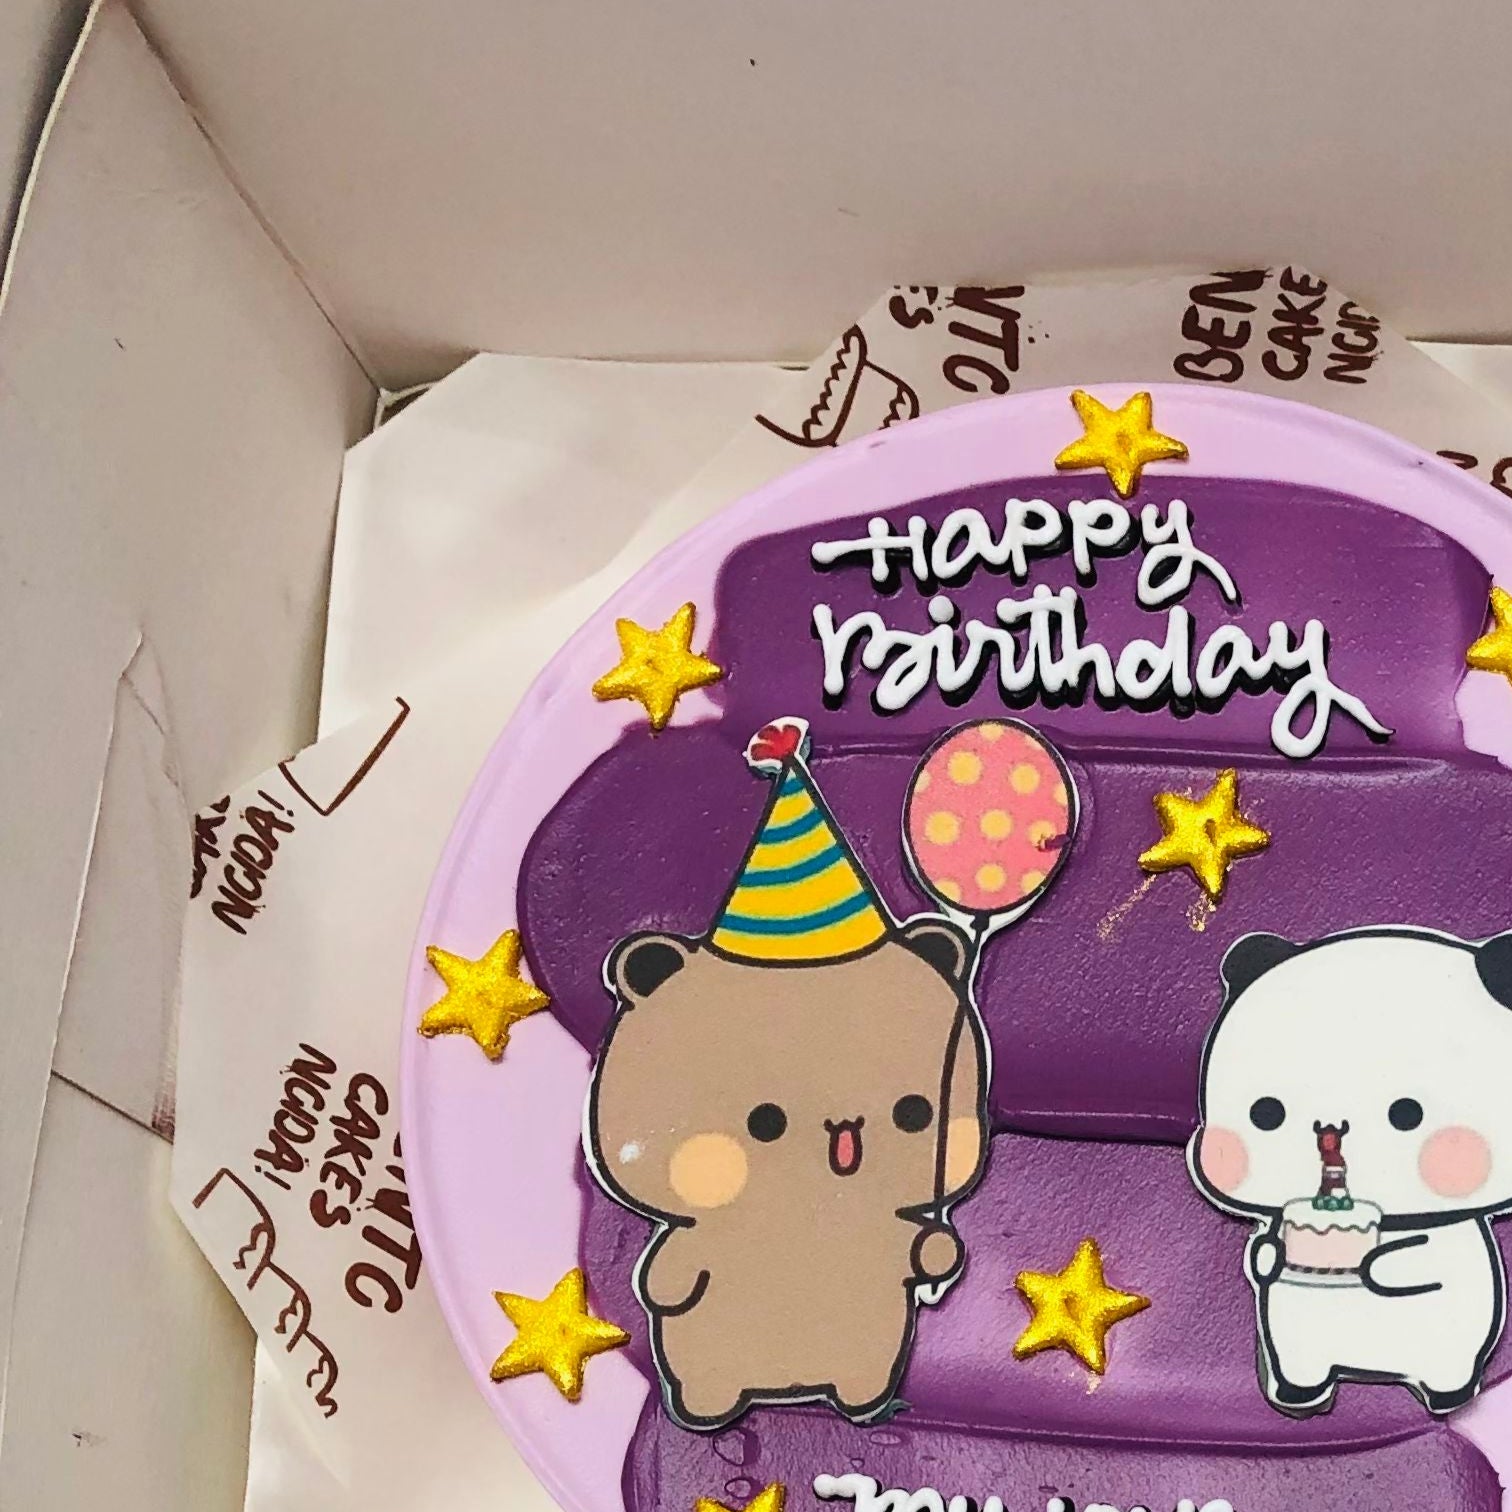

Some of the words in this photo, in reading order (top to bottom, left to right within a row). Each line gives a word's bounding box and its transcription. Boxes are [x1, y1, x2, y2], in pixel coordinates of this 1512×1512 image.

[811, 499, 1238, 606] Happy
[811, 584, 1396, 758] Birthday
[309, 1072, 389, 1229] CAKES
